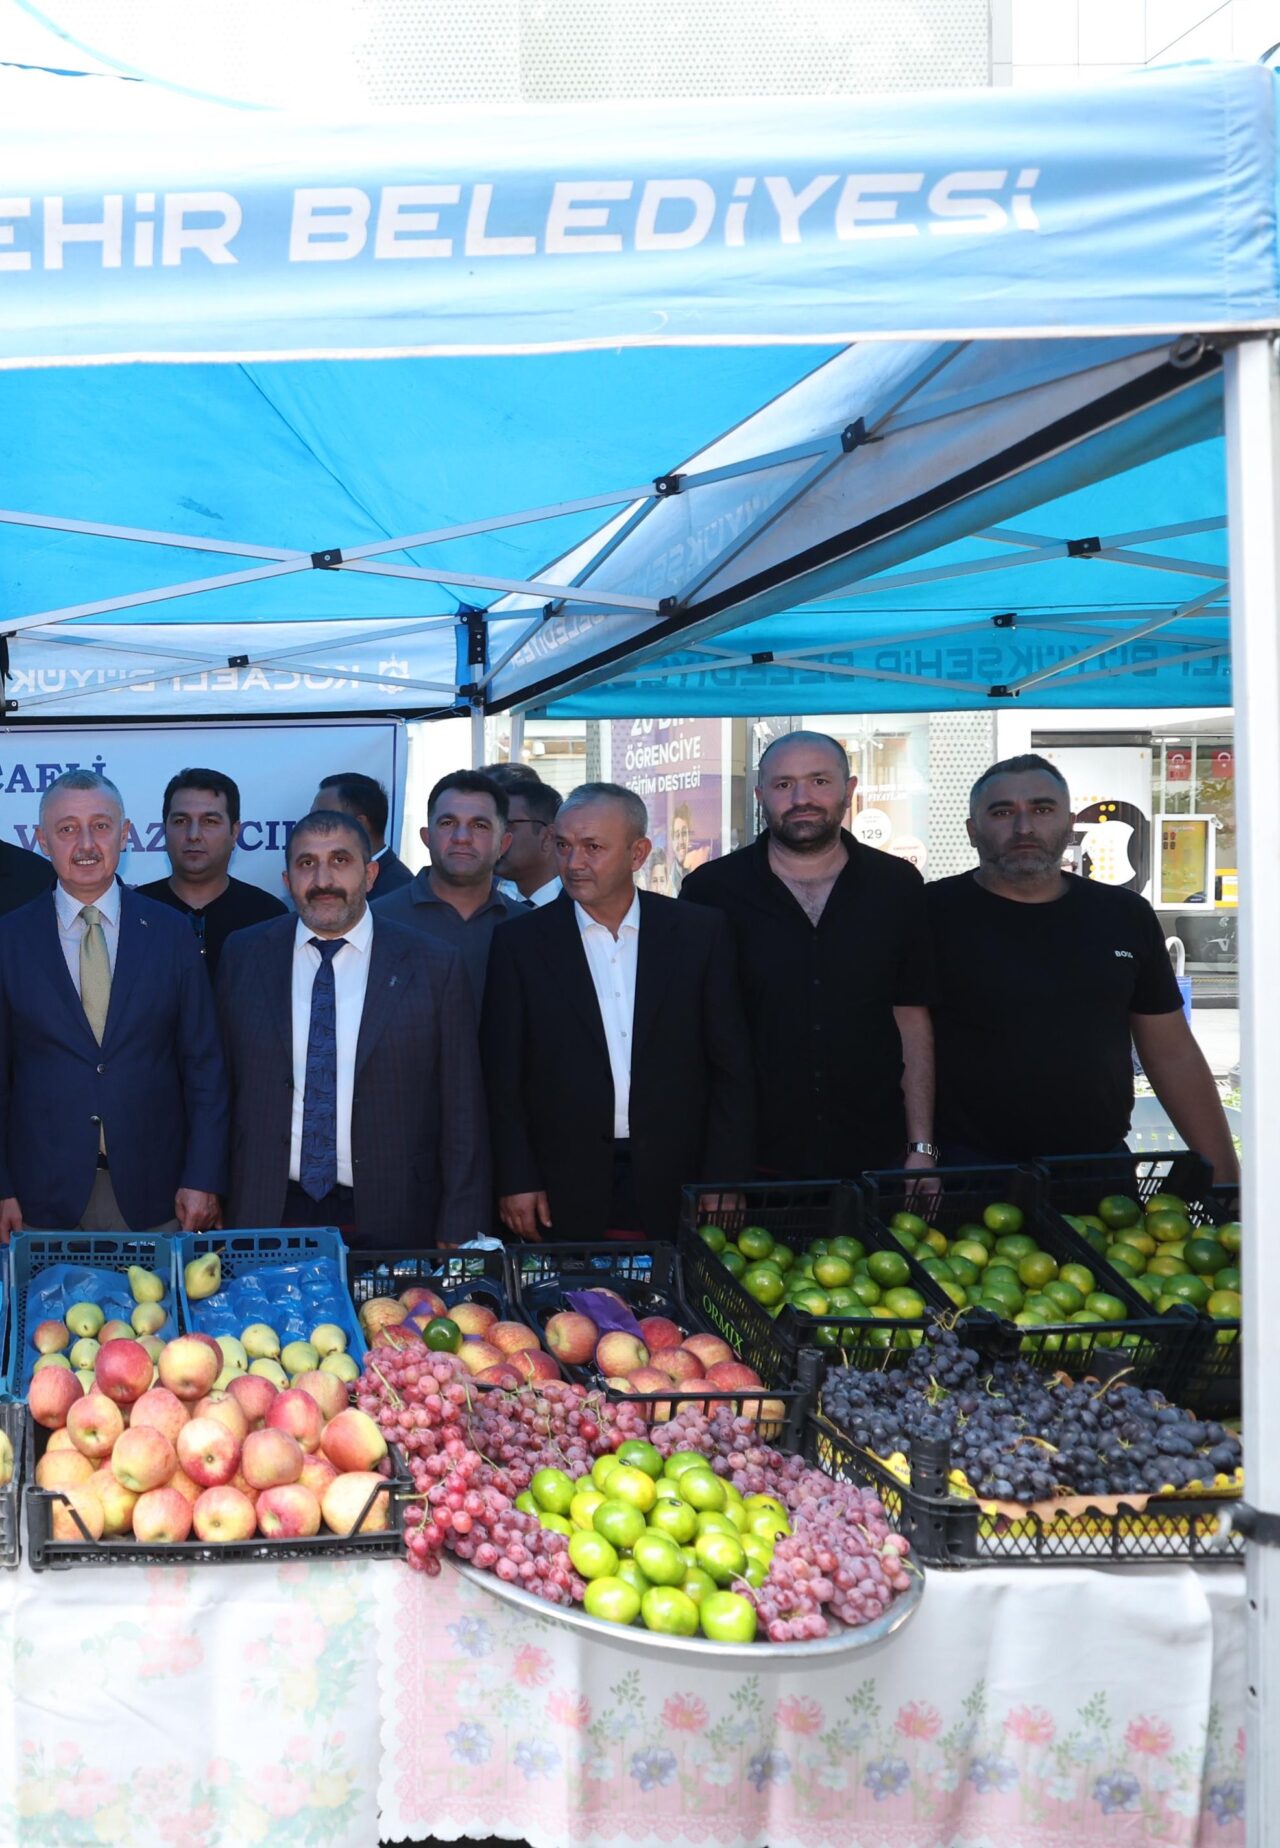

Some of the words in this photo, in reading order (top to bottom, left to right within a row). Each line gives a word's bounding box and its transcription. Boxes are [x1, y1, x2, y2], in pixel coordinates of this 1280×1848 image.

[625, 733, 702, 770] ÖĞRENCİYE
[658, 766, 701, 793] DESTEĞİ
[861, 829, 883, 840] 129
